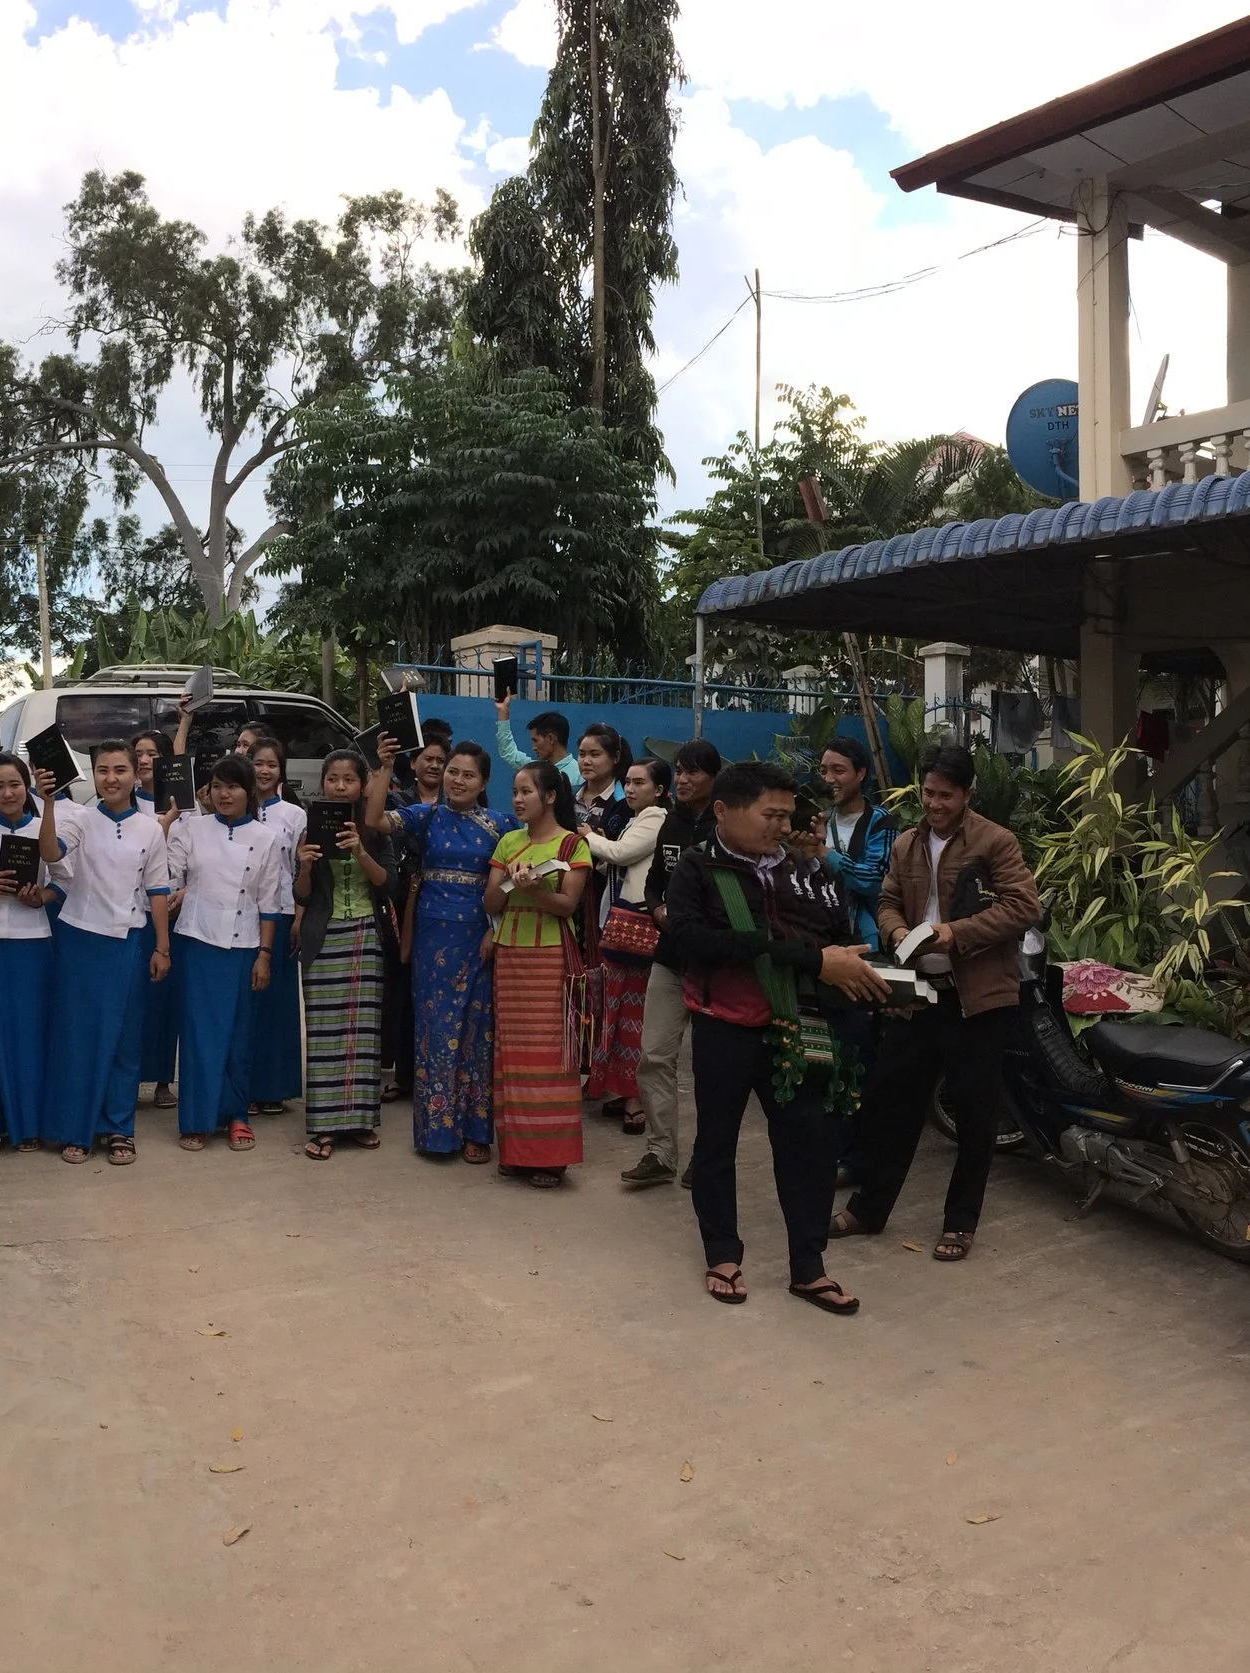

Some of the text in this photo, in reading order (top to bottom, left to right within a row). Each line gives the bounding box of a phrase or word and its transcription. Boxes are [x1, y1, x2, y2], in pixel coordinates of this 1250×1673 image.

[1029, 408, 1054, 418] SKY
[1047, 420, 1069, 430] DTH
[1115, 1077, 1154, 1092] Dream
